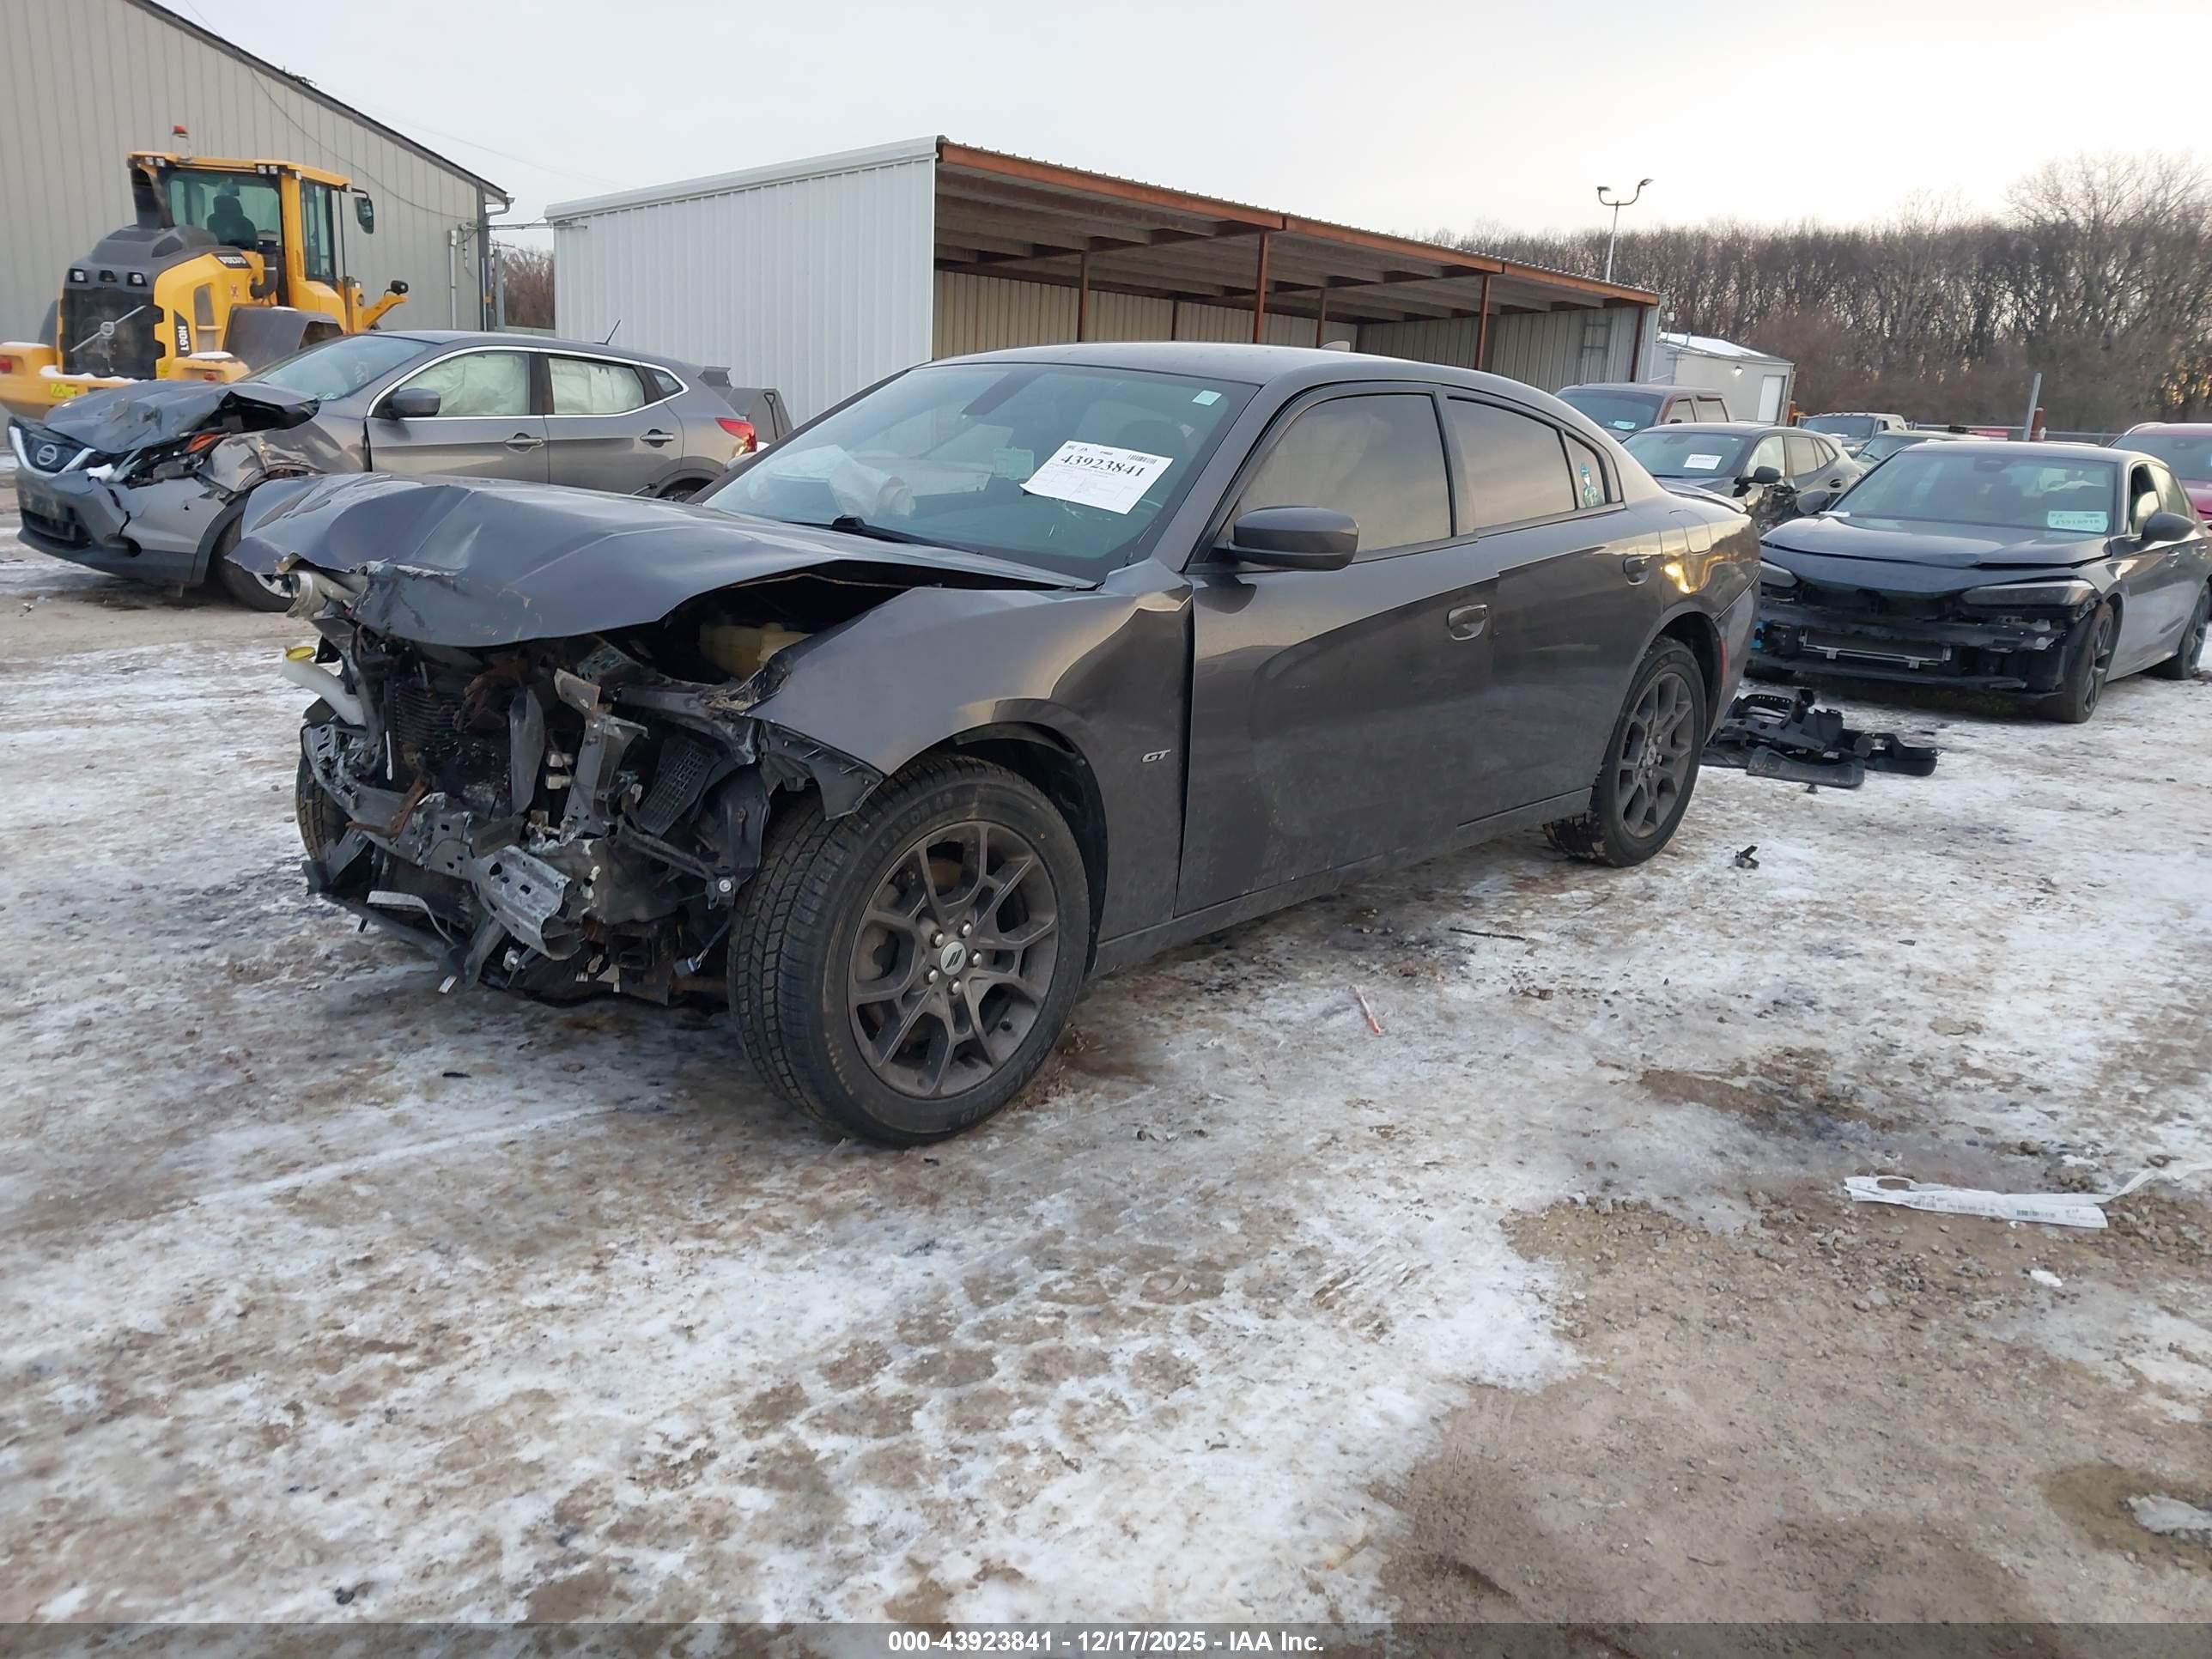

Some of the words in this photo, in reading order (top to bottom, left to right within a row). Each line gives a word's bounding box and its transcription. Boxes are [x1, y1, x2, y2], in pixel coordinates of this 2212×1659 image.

[178, 325, 190, 351] L90H
[1060, 453, 1146, 477] 43923841
[1142, 749, 1171, 763] GT
